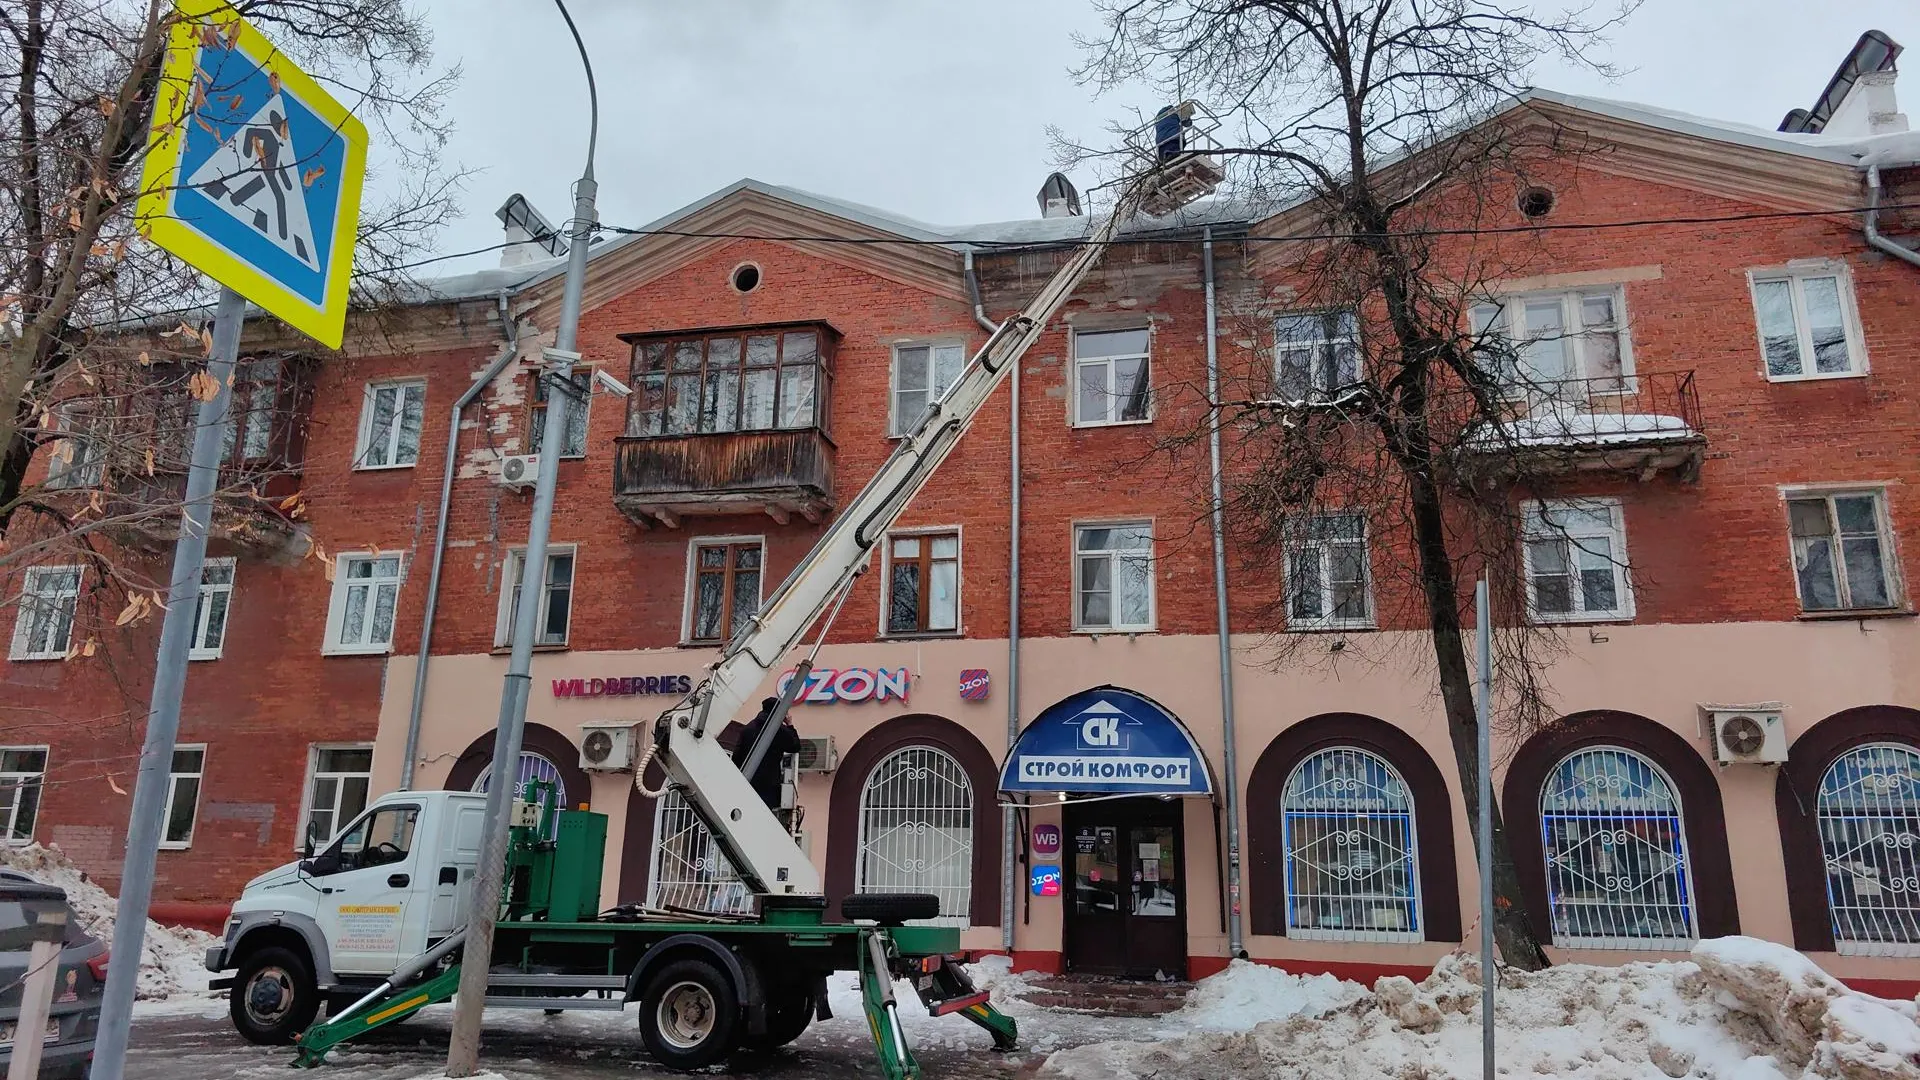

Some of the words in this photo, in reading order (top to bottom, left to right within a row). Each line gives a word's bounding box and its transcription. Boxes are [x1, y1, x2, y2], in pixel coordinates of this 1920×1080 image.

[552, 675, 692, 698] WILDBERRIES
[1082, 717, 1119, 746] СК
[1025, 759, 1084, 777] СТРОЙ
[1088, 763, 1188, 779] КОМФОРТ
[1306, 798, 1385, 809] САНТЕХНИКА
[1035, 833, 1058, 845] WB
